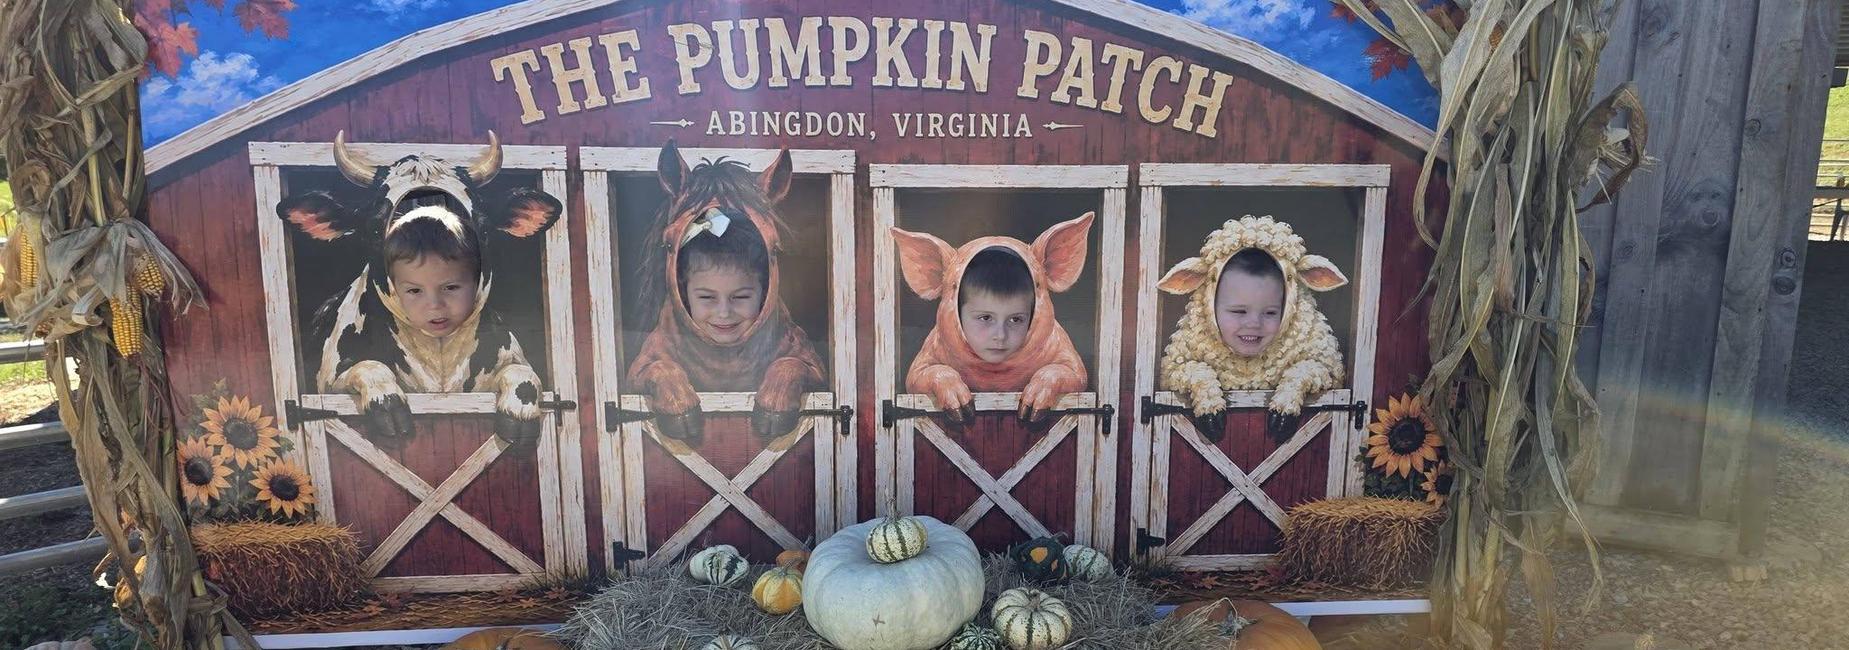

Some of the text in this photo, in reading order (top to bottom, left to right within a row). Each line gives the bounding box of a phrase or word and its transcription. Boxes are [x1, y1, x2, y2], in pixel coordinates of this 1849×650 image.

[490, 17, 1234, 138] THE PUMPKIN PATCH
[706, 111, 1033, 140] ABINGDON, VIRGINIA
